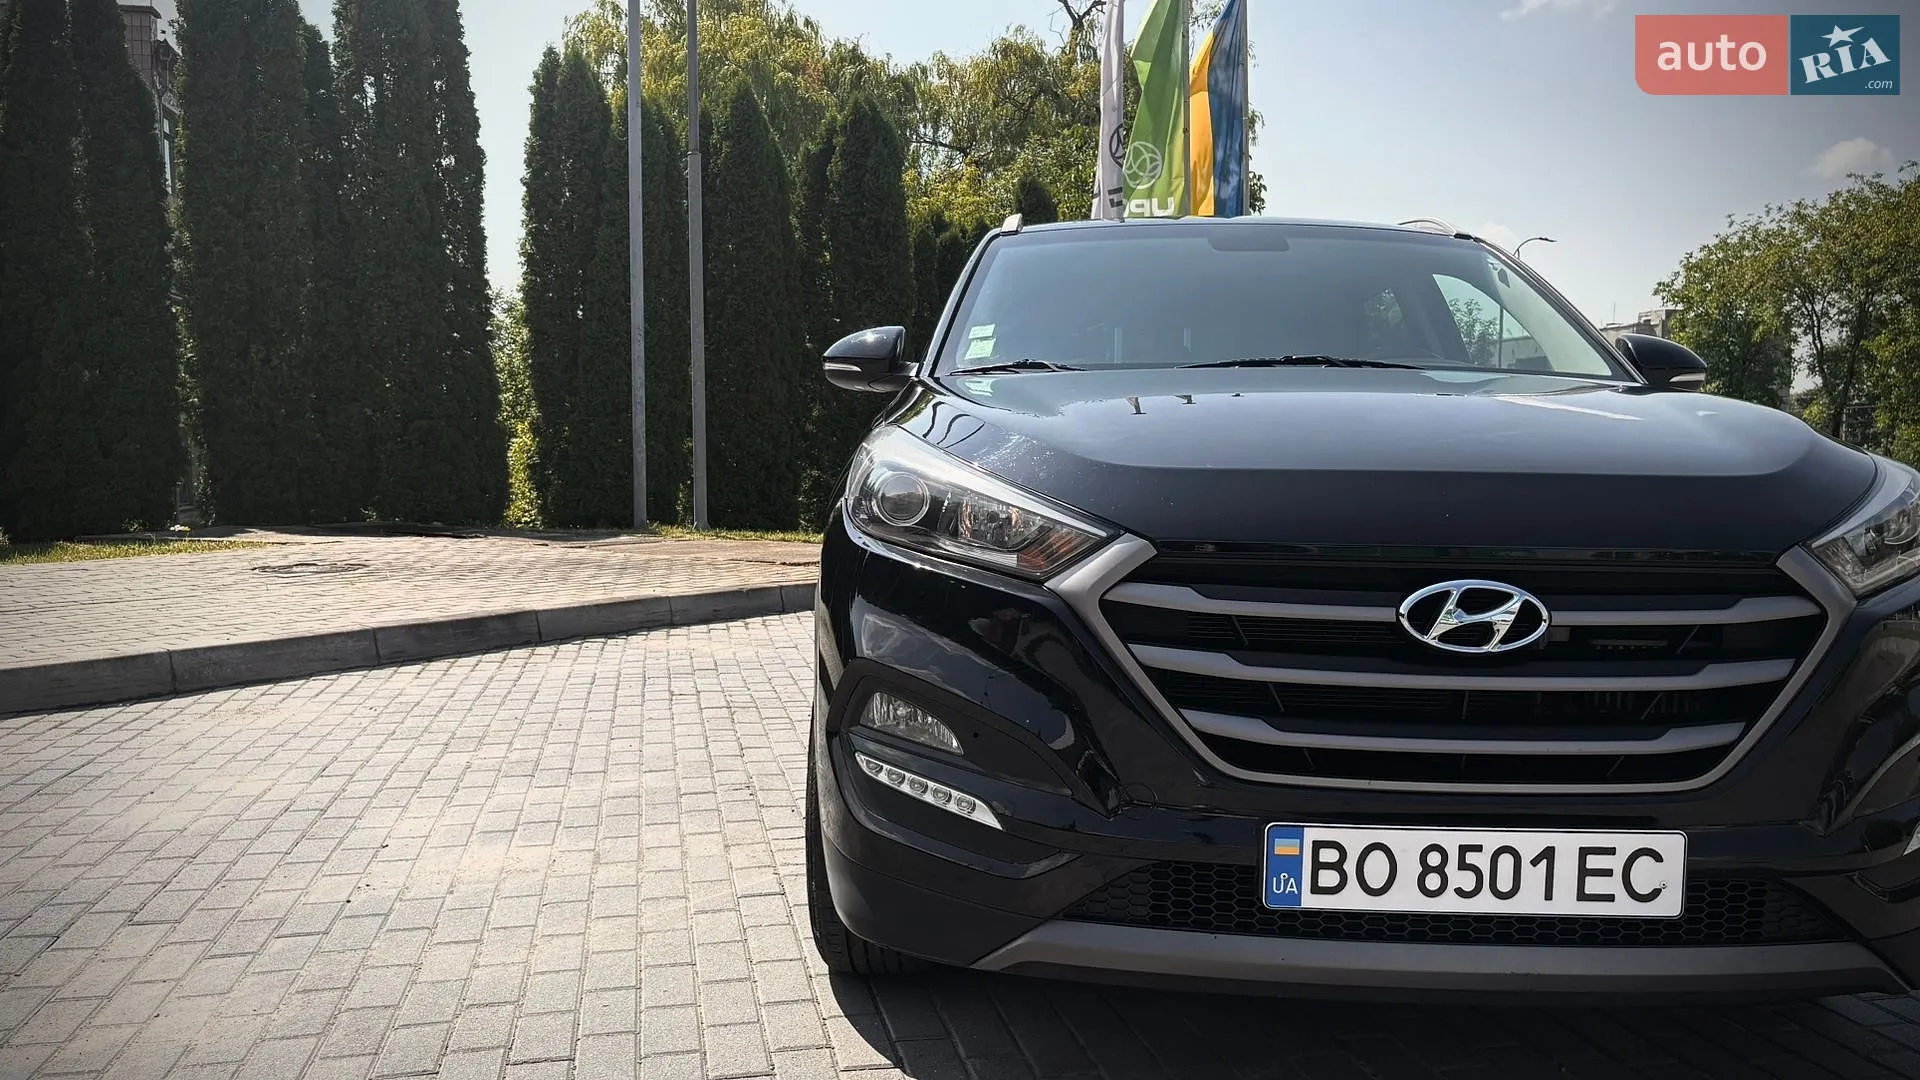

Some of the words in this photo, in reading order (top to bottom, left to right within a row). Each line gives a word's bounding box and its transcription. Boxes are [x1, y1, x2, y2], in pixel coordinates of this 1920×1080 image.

[1273, 876, 1298, 894] UA
[1309, 839, 1398, 897] BO
[1416, 843, 1556, 901] 8501
[1576, 846, 1665, 903] EC
